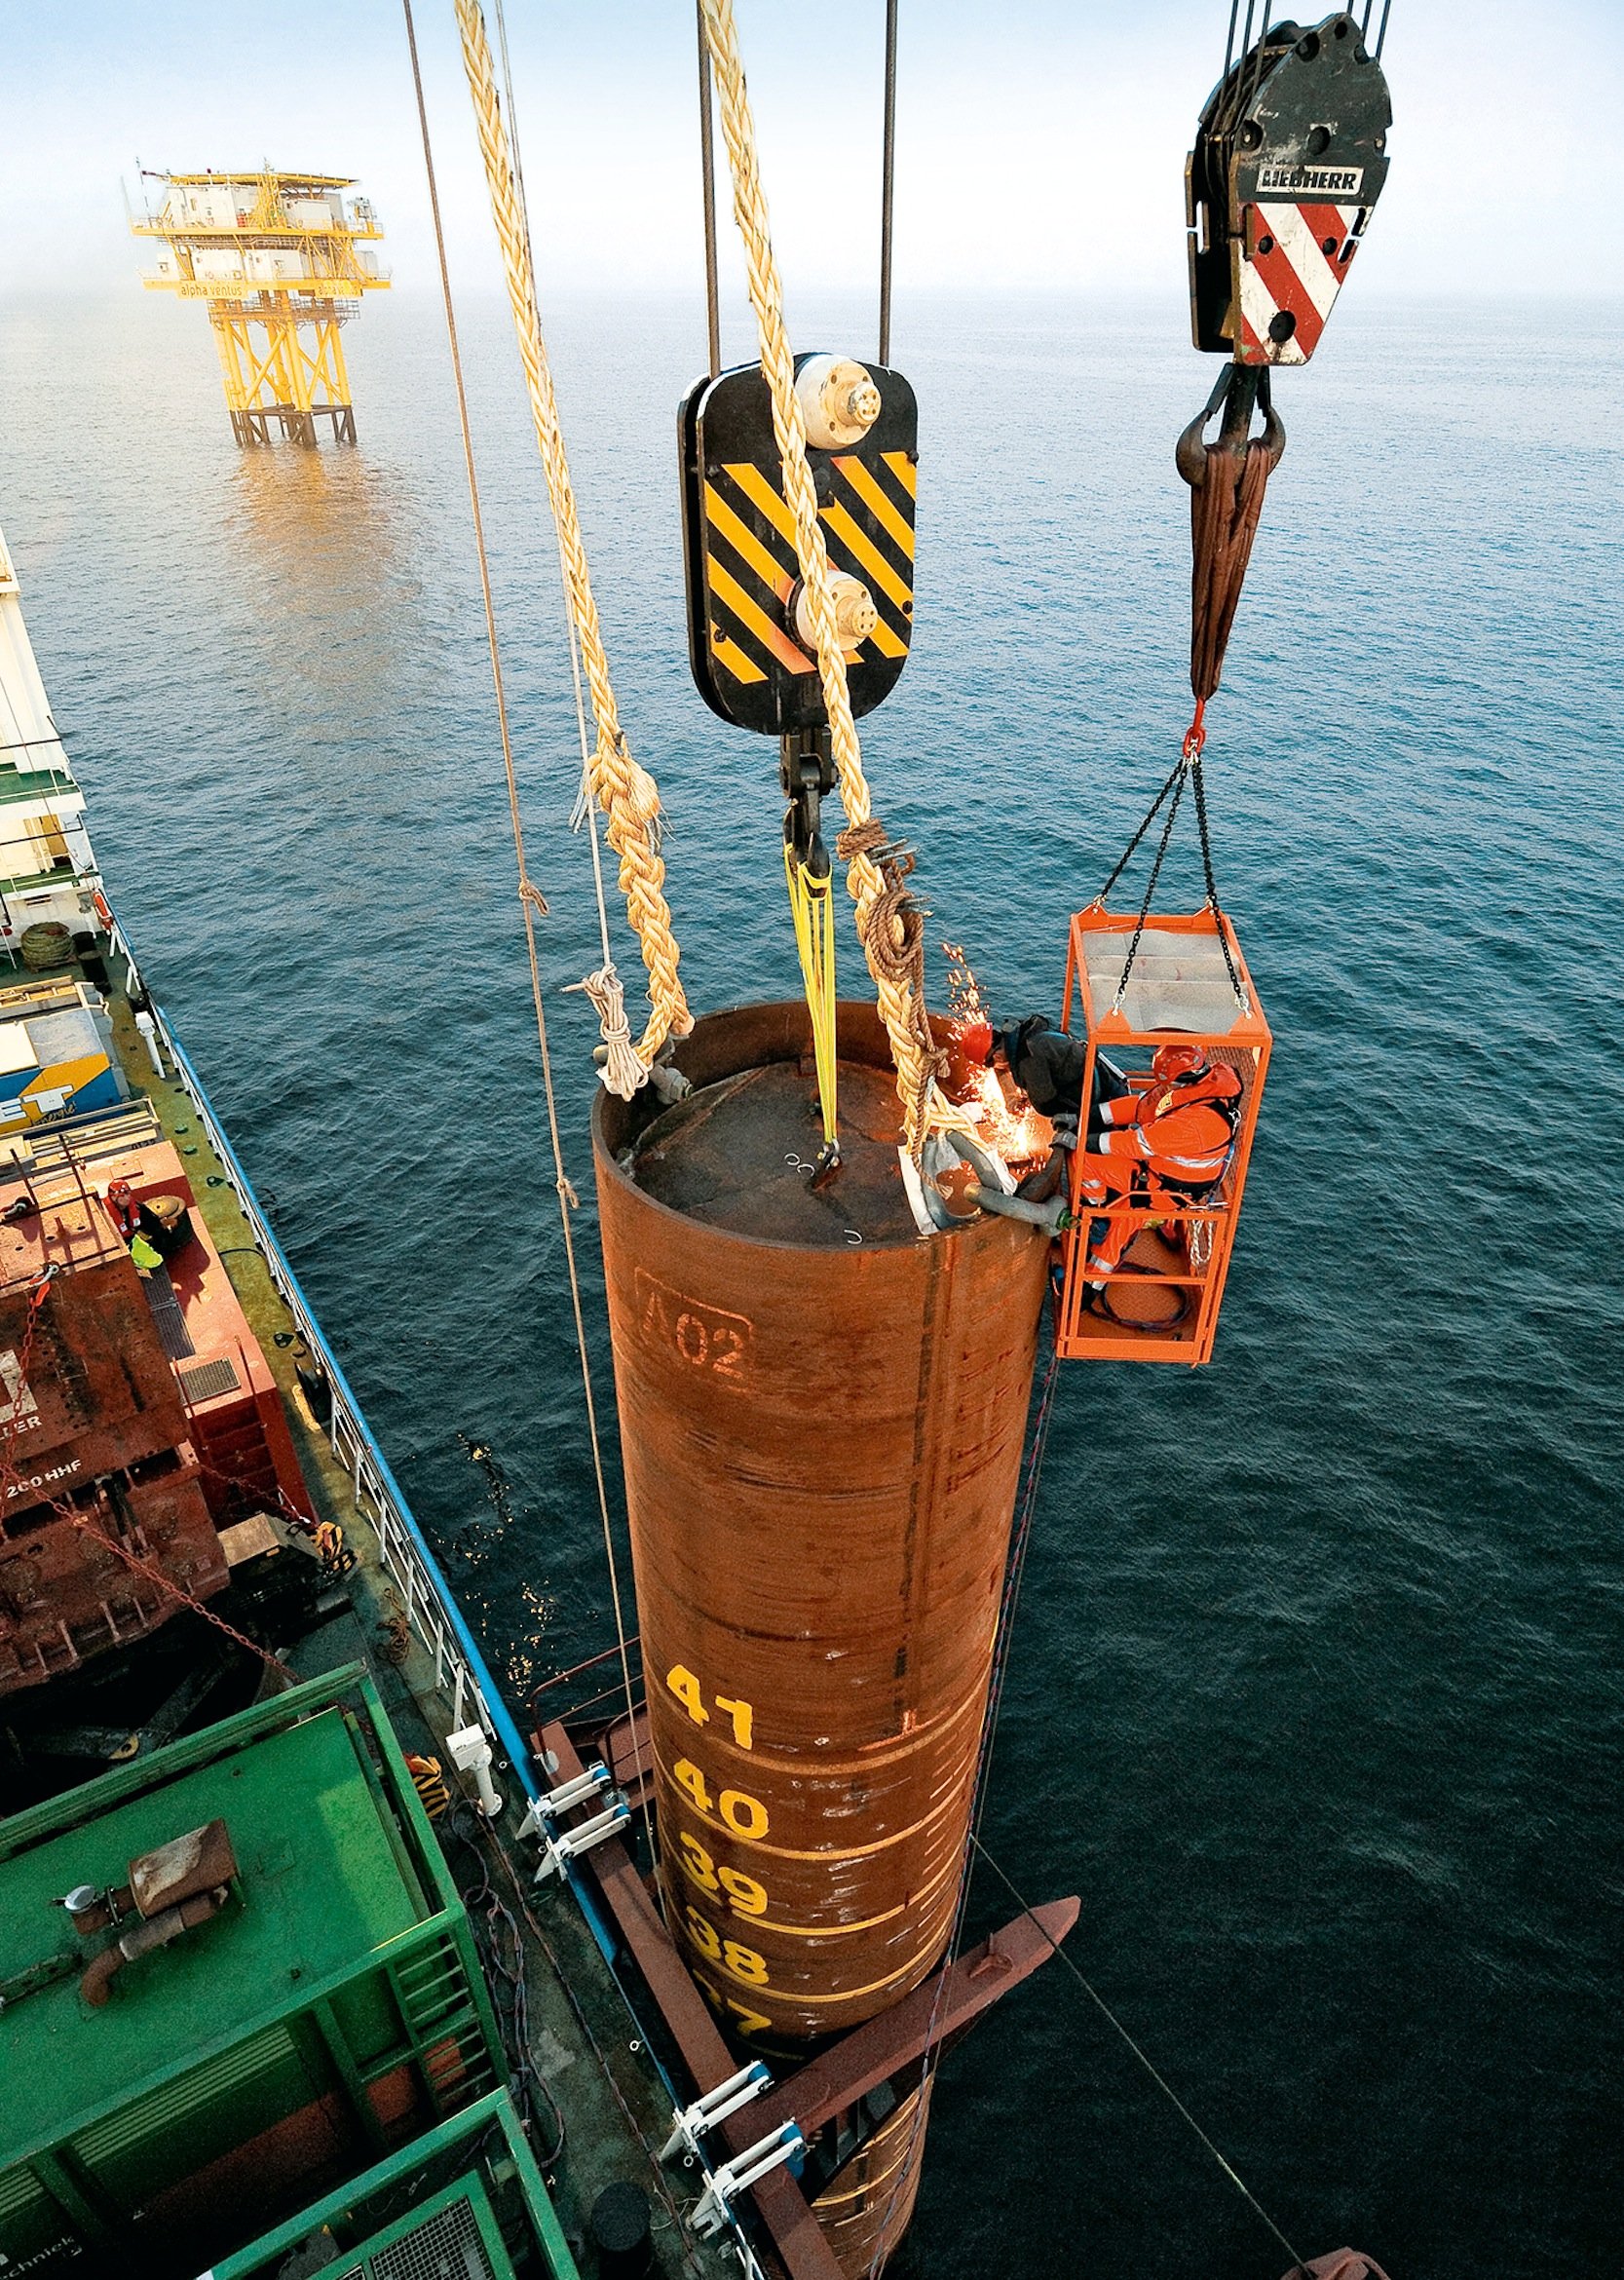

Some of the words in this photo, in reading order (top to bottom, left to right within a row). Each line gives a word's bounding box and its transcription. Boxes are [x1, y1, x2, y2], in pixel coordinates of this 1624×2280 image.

[181, 284, 208, 298] alpha
[209, 285, 243, 296] ventus
[640, 1291, 744, 1379] A02
[45, 1459, 82, 1481] HHF
[666, 1664, 753, 1750] 41
[674, 1758, 769, 1840] 40
[680, 1831, 768, 1916] 39
[686, 1905, 769, 1985] 38
